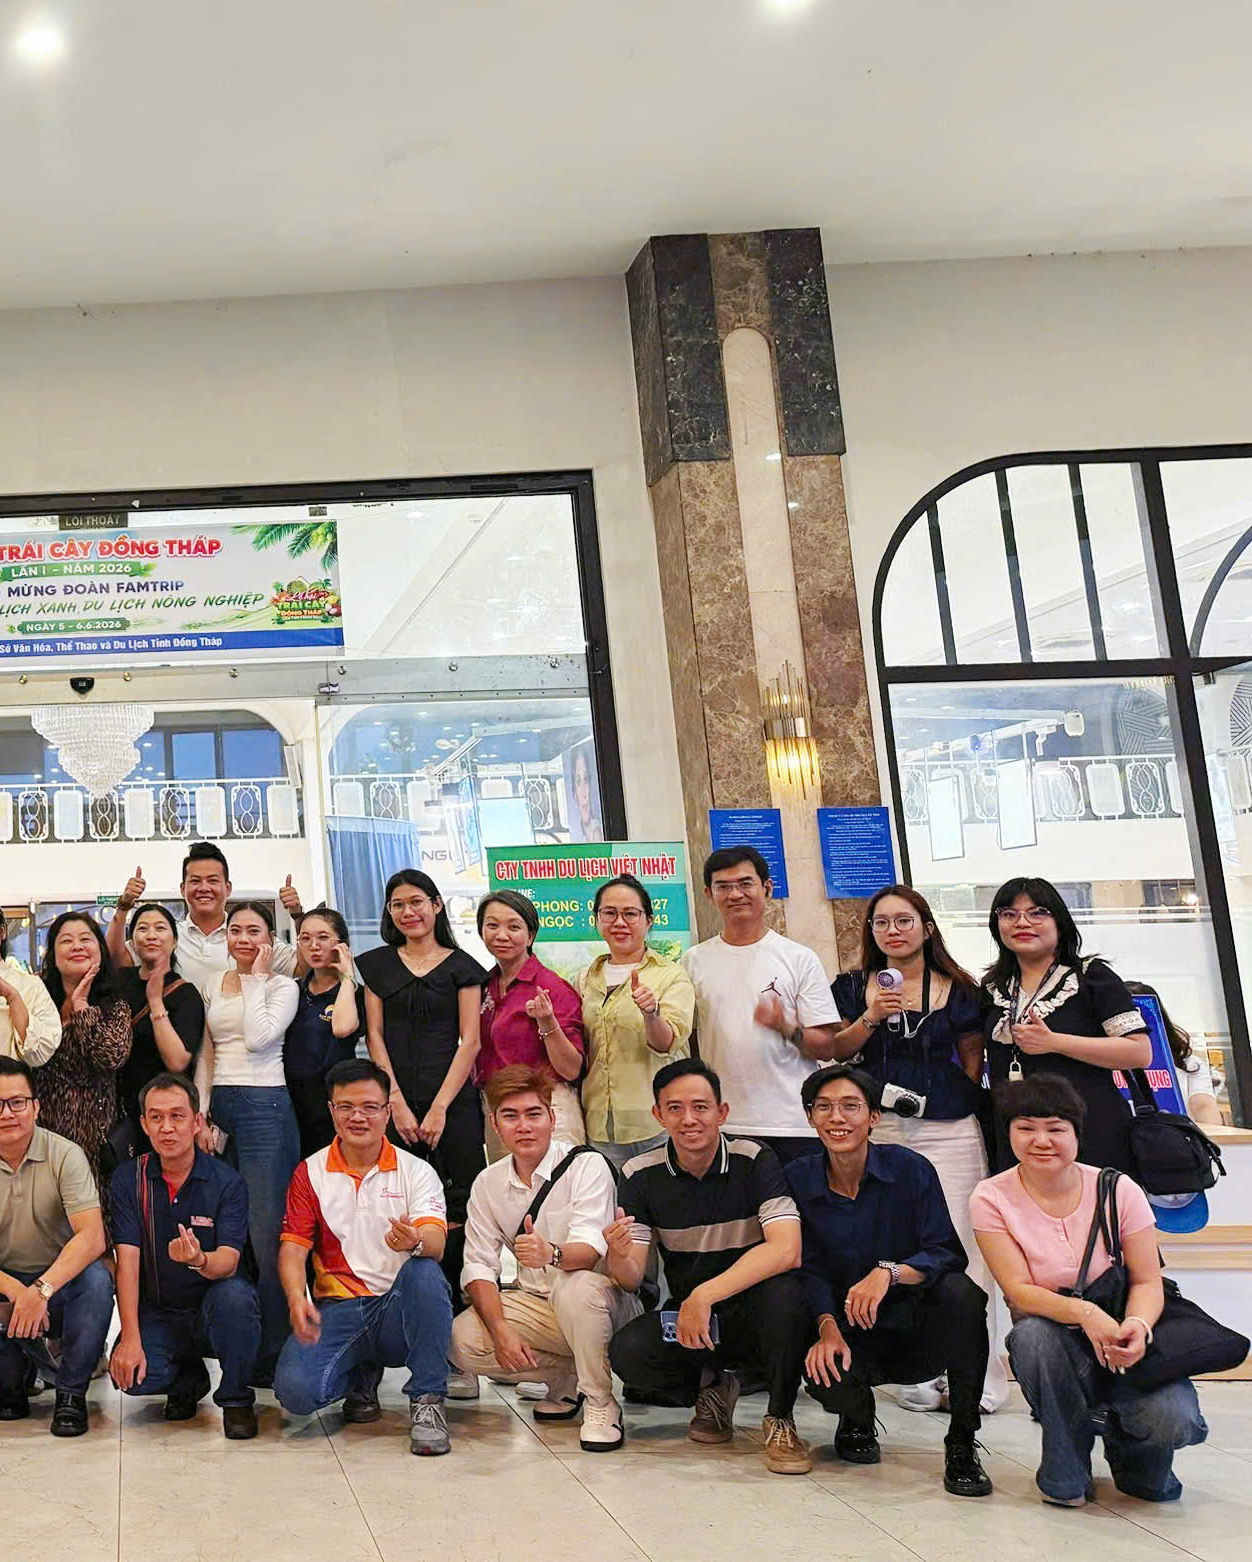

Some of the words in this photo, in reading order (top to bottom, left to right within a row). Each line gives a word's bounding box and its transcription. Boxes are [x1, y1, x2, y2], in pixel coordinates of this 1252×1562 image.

[49, 537, 93, 560] CÂY
[98, 535, 160, 558] ĐỒNG
[164, 535, 222, 558] THÁP
[63, 562, 95, 574] NĂM
[98, 562, 132, 574] 2026
[8, 582, 57, 598] MỪNG
[63, 580, 110, 595] ĐOÀN
[116, 579, 185, 594] FAMTRIP
[83, 599, 104, 612] DU
[109, 598, 148, 613] LỊCH
[151, 594, 197, 609] NÔNG
[203, 591, 265, 609] NGHIỆP
[26, 621, 56, 632] NGÀY
[75, 620, 122, 630] 6.6.2026
[13, 642, 31, 654] Văn
[56, 640, 73, 652] Thể
[75, 642, 98, 651] Thao
[100, 640, 112, 650] và
[114, 640, 126, 650] Du
[128, 638, 149, 651] Lịch
[173, 636, 198, 649] Đồng
[200, 637, 223, 648] Tháp
[495, 860, 520, 881] CTY
[522, 858, 556, 879] TNHH
[558, 858, 577, 878] DU
[579, 858, 608, 882] LỊCH
[610, 853, 640, 876] VIỆT
[640, 852, 677, 880] NHẬT
[1144, 1069, 1173, 1092] ỤNG
